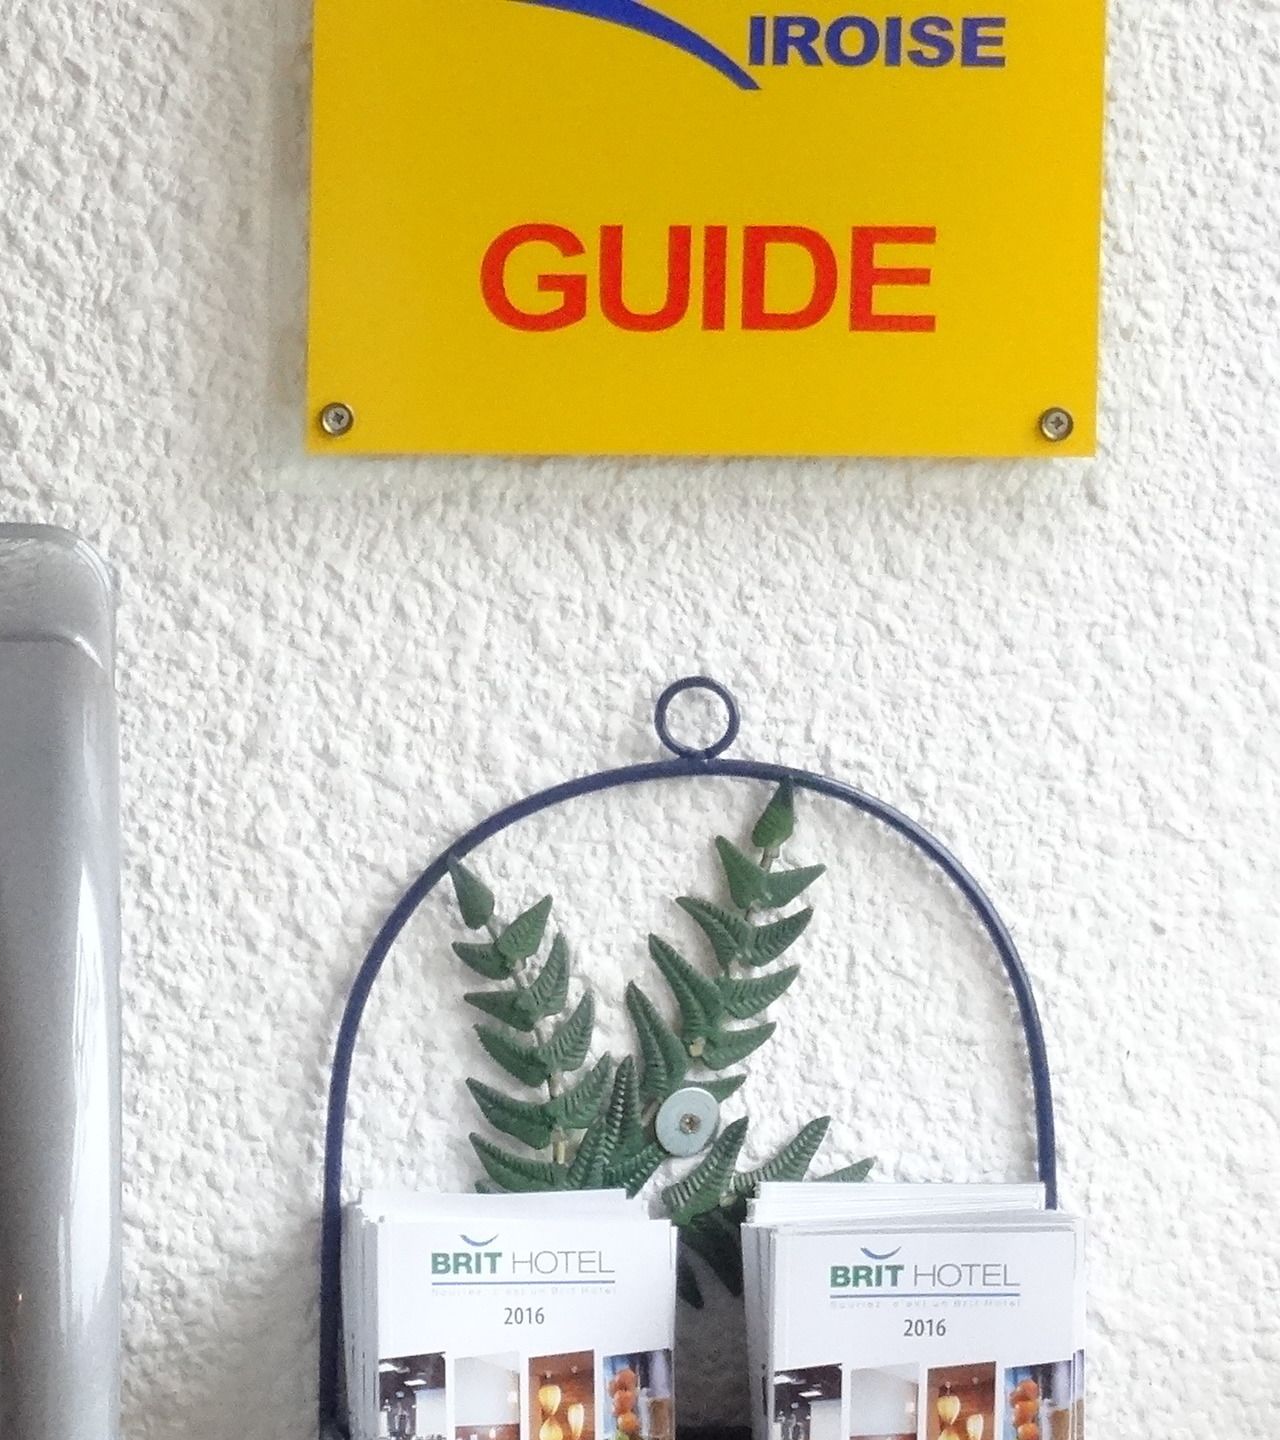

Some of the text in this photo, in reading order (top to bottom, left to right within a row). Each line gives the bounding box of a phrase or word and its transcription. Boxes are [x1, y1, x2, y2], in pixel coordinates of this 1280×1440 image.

[747, 15, 1007, 69] IROISE
[479, 223, 937, 333] GUIDE
[430, 1249, 616, 1275] BRIT HOTEL
[829, 1262, 1022, 1289] BRIT HOTEL
[504, 1306, 545, 1326] 2016
[903, 1318, 947, 1338] 2016
